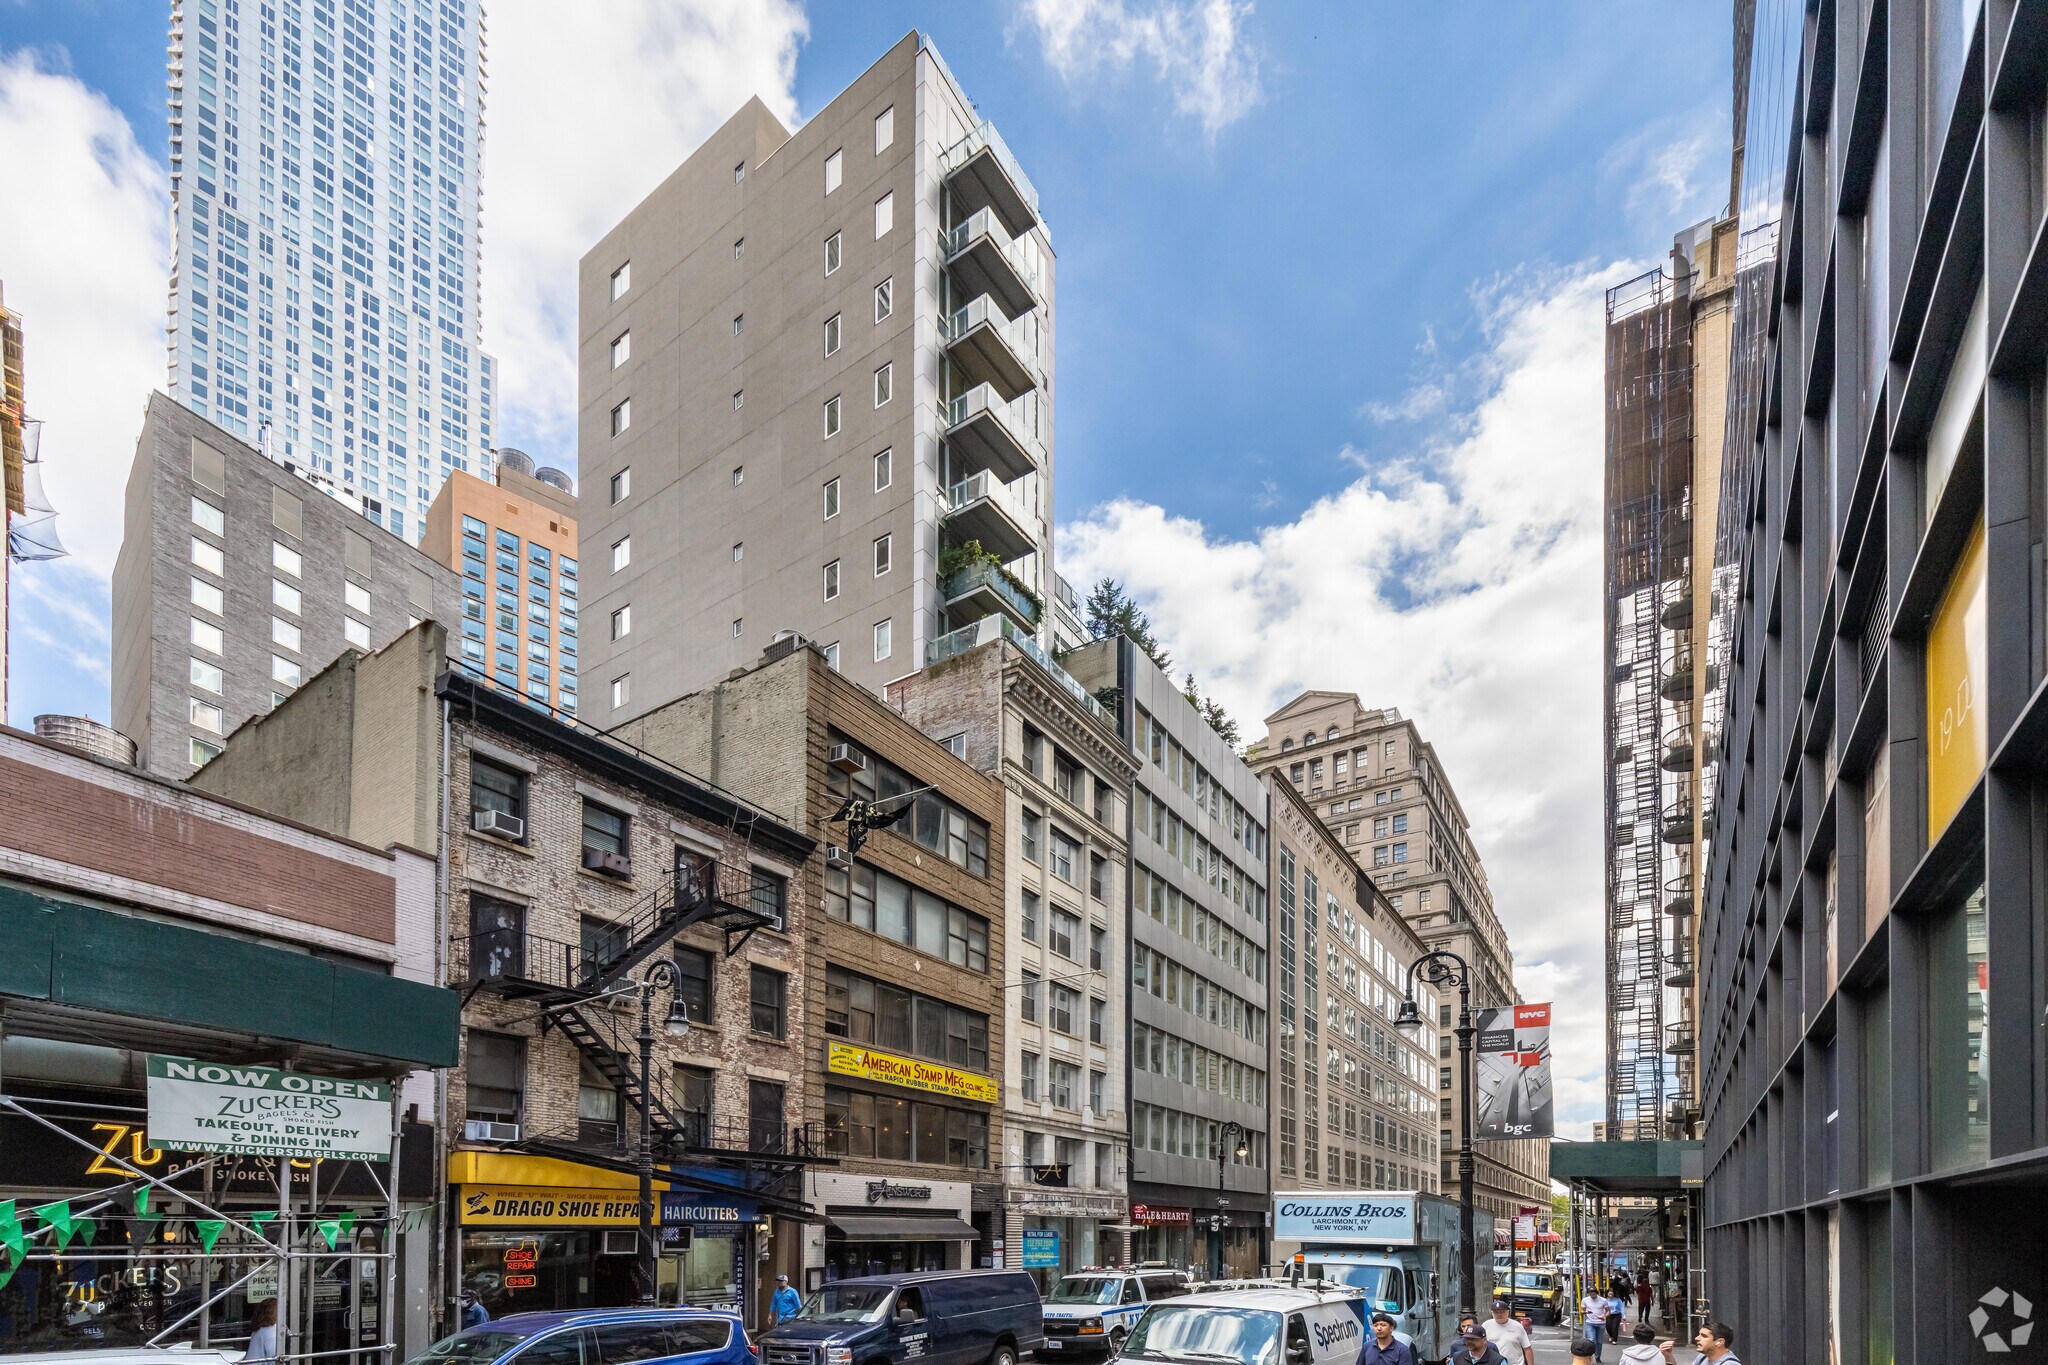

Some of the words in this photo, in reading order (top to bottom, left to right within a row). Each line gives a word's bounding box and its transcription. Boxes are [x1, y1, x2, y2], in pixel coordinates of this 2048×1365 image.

[1940, 707, 1953, 757] 19
[1519, 1010, 1546, 1019] NYC
[862, 1051, 911, 1077] AMERICAN
[914, 1063, 943, 1084] STAMP
[945, 1069, 964, 1089] MFG
[166, 1062, 270, 1087] NOW
[281, 1076, 379, 1100] OPEN
[884, 1074, 904, 1084] RAPID
[906, 1078, 929, 1089] RUBBER
[930, 1083, 950, 1094] STAMP
[217, 1095, 342, 1119] ZUCKER'S
[257, 1110, 298, 1121] BAGELS
[303, 1110, 315, 1118] &
[285, 1125, 360, 1139] DELIVERY
[1503, 1123, 1532, 1136] bgc
[231, 1133, 246, 1143] &
[251, 1135, 309, 1147] DINING
[315, 1139, 331, 1148] IN
[168, 1141, 378, 1162] WWW.ZUCKERSBAGELS.COM
[492, 1199, 555, 1218] DRAGO
[558, 1201, 601, 1218] SHOE
[603, 1202, 656, 1218] REPAR
[664, 1205, 739, 1220] HAIRCUTTERS
[1281, 1203, 1353, 1218] COLLINS
[1355, 1203, 1407, 1218] BROS.
[1312, 1218, 1359, 1226] LARCHMONT,
[509, 1251, 533, 1259] SHOE
[507, 1262, 535, 1270] REPAIR
[252, 1277, 278, 1285] PICK-U
[508, 1277, 533, 1286] SHINE
[1129, 1312, 1144, 1326] NY
[1314, 1317, 1355, 1349] Spectrum
